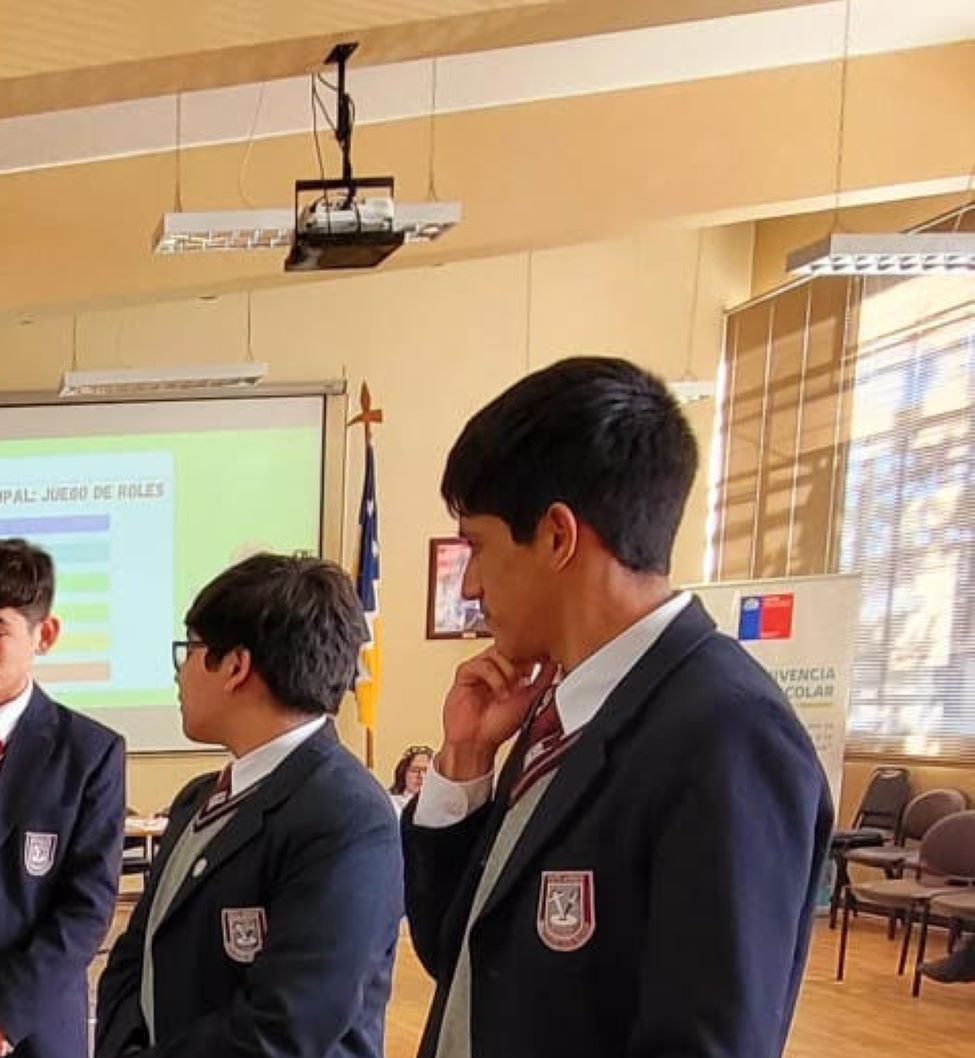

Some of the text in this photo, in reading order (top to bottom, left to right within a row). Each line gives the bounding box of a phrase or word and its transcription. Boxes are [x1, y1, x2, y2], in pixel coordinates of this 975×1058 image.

[42, 486, 87, 502] JUEGO
[93, 485, 112, 500] DE
[117, 483, 165, 499] ROLES
